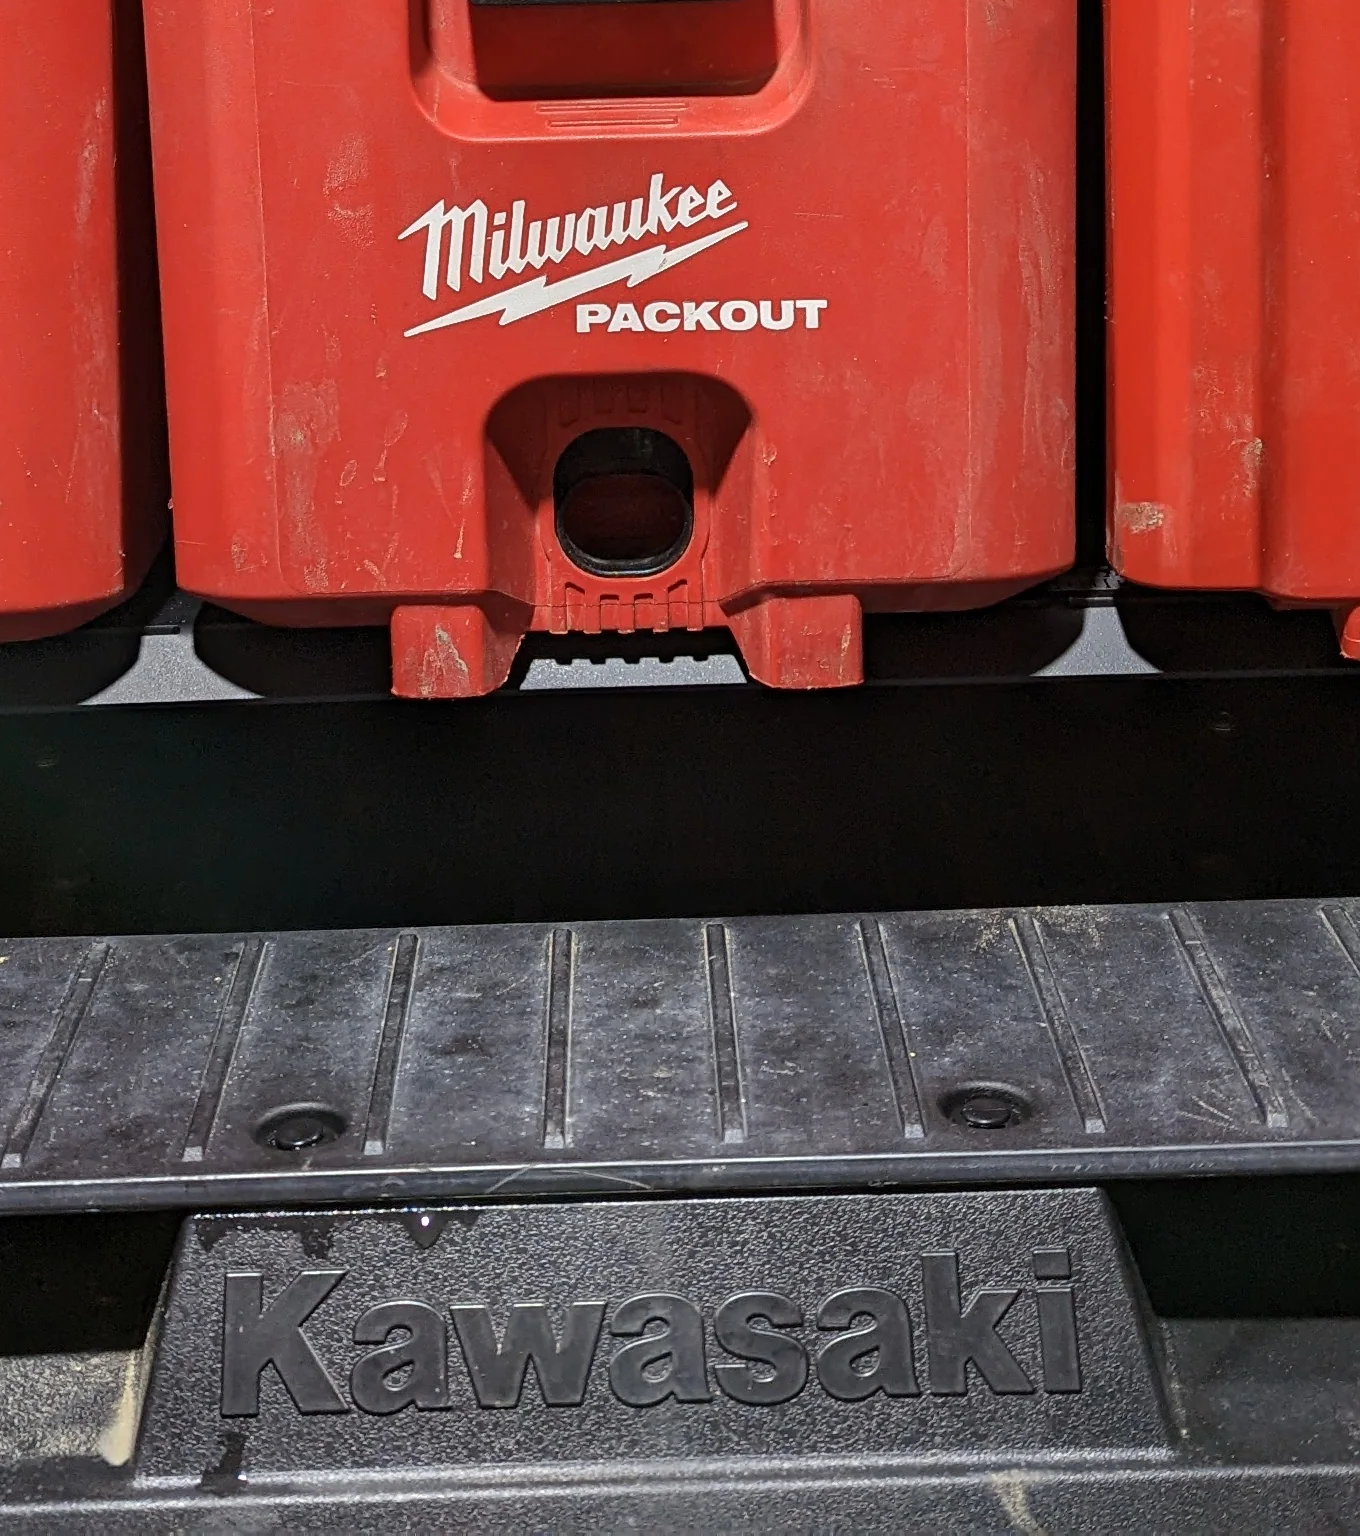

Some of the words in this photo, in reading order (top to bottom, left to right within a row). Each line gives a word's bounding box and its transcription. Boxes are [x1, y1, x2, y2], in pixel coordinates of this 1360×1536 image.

[397, 172, 738, 301] Milwaukee
[575, 298, 828, 333] PACKOUT
[219, 1247, 1085, 1420] Kawasaki
